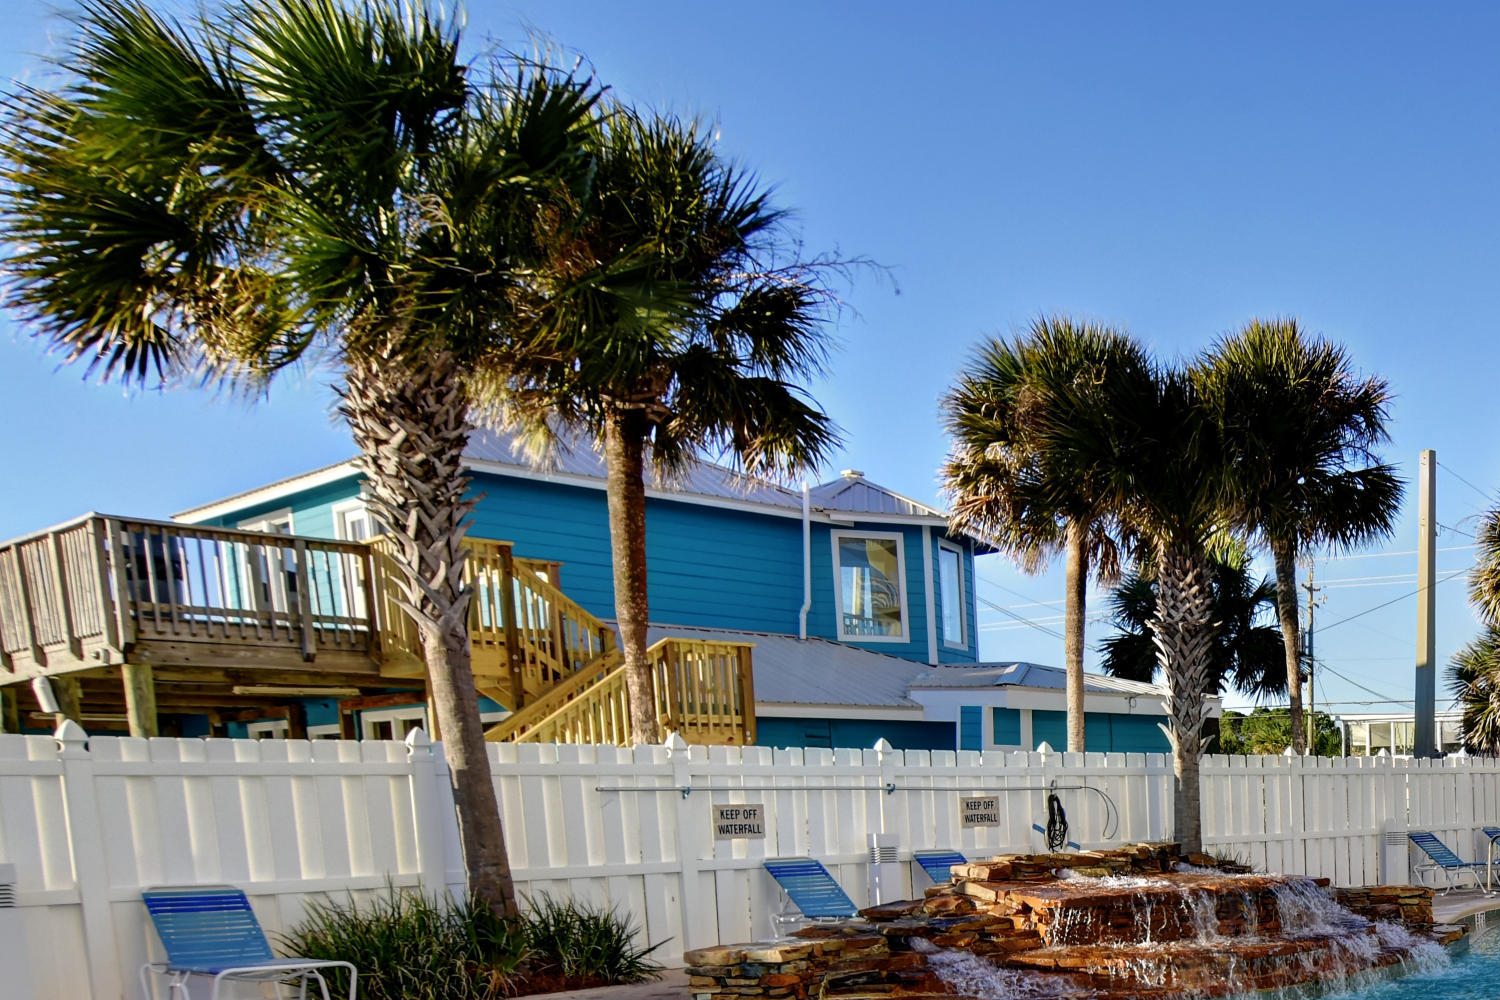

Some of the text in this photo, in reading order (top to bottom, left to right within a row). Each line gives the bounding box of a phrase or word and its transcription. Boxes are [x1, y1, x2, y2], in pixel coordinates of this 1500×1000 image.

[966, 800, 995, 811] KEEP OFF
[720, 809, 758, 820] KEEP OFF
[964, 813, 998, 823] WATERFALL
[717, 823, 762, 835] WATERFALL
